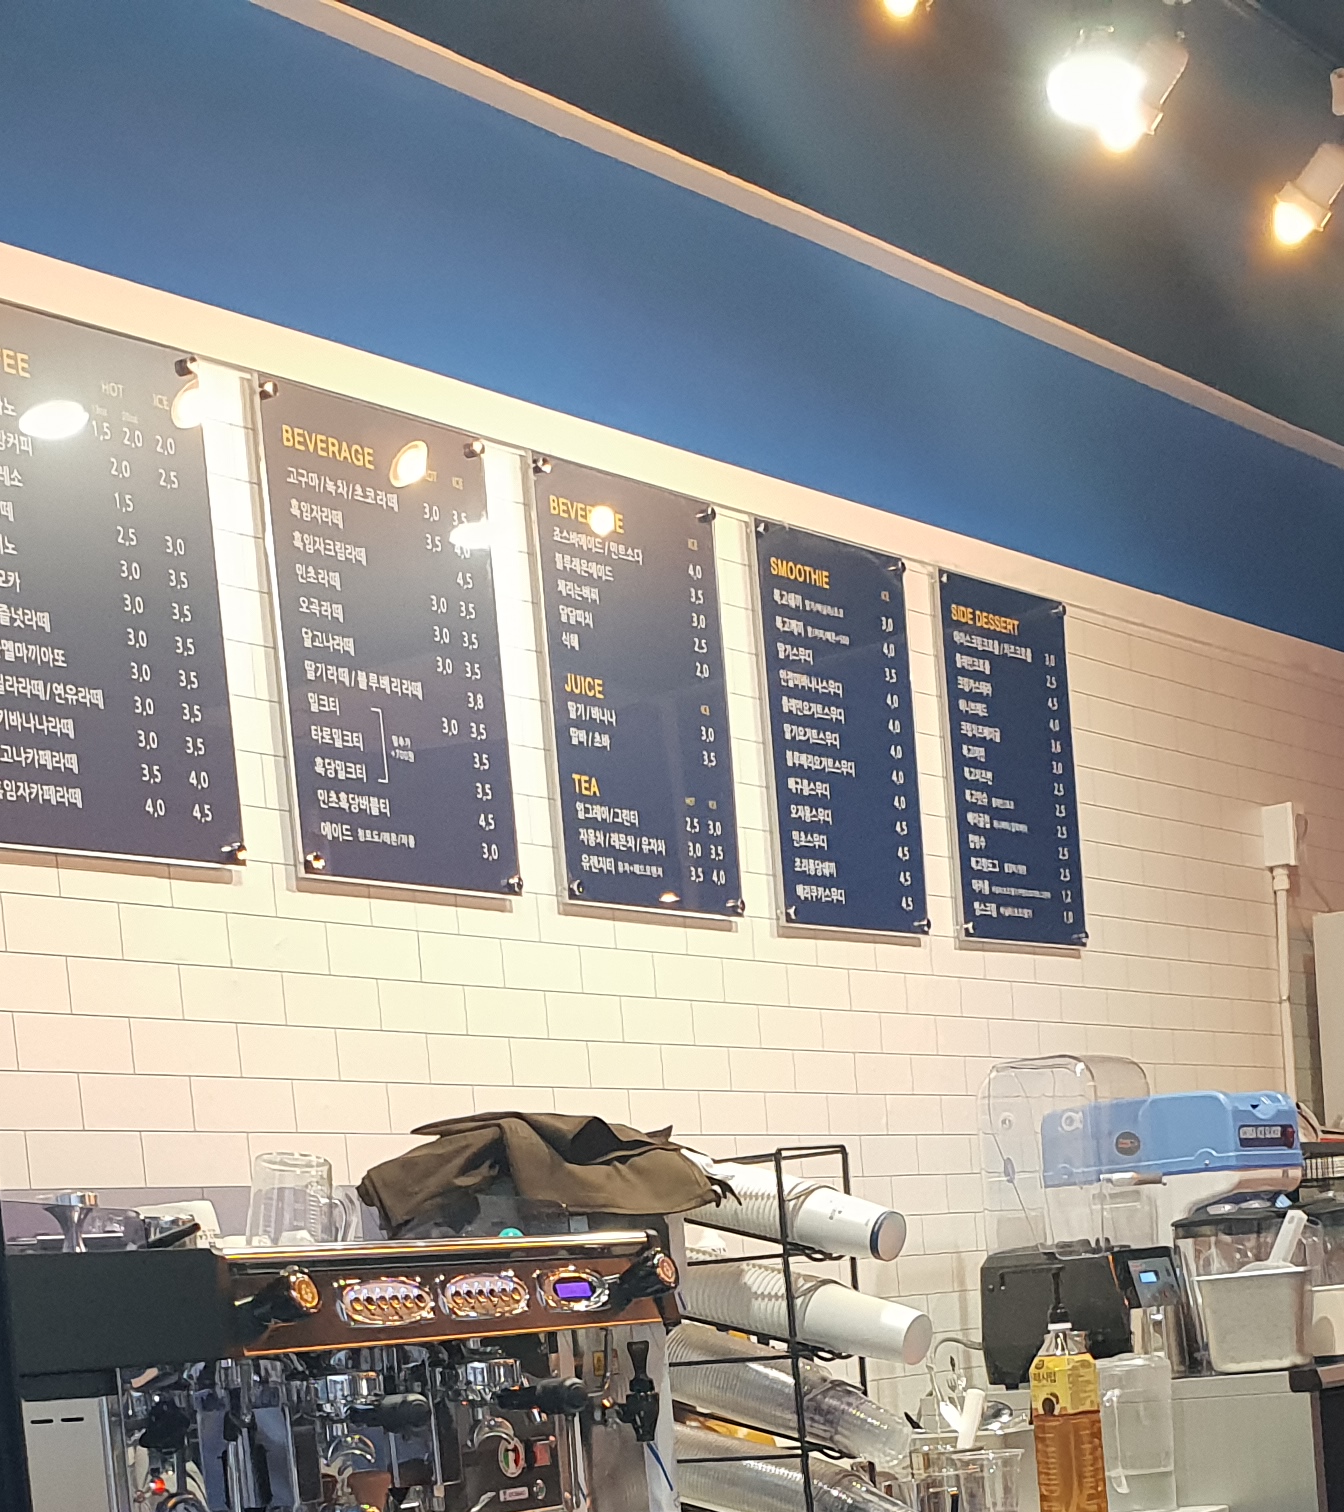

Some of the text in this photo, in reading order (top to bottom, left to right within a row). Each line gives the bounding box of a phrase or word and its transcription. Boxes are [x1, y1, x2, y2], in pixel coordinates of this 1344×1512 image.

[282, 424, 375, 470] BEVERAGE
[290, 499, 343, 529] 흑임자라떼
[292, 531, 366, 566] 흑임자크림라떼
[770, 557, 830, 589] SMOOTHIE
[299, 596, 344, 623] 오곡라떼
[950, 604, 1020, 636] SIDE DESSERT
[301, 628, 355, 656] 달고나라떼
[565, 673, 604, 699] JUICE
[308, 693, 340, 716] 밀크티
[311, 725, 363, 751] 타로밀크티
[315, 757, 367, 782] 흑당밀크티
[572, 773, 600, 797] TEA
[318, 789, 390, 817] 민초흑당버블티
[321, 821, 353, 841] 에이드
